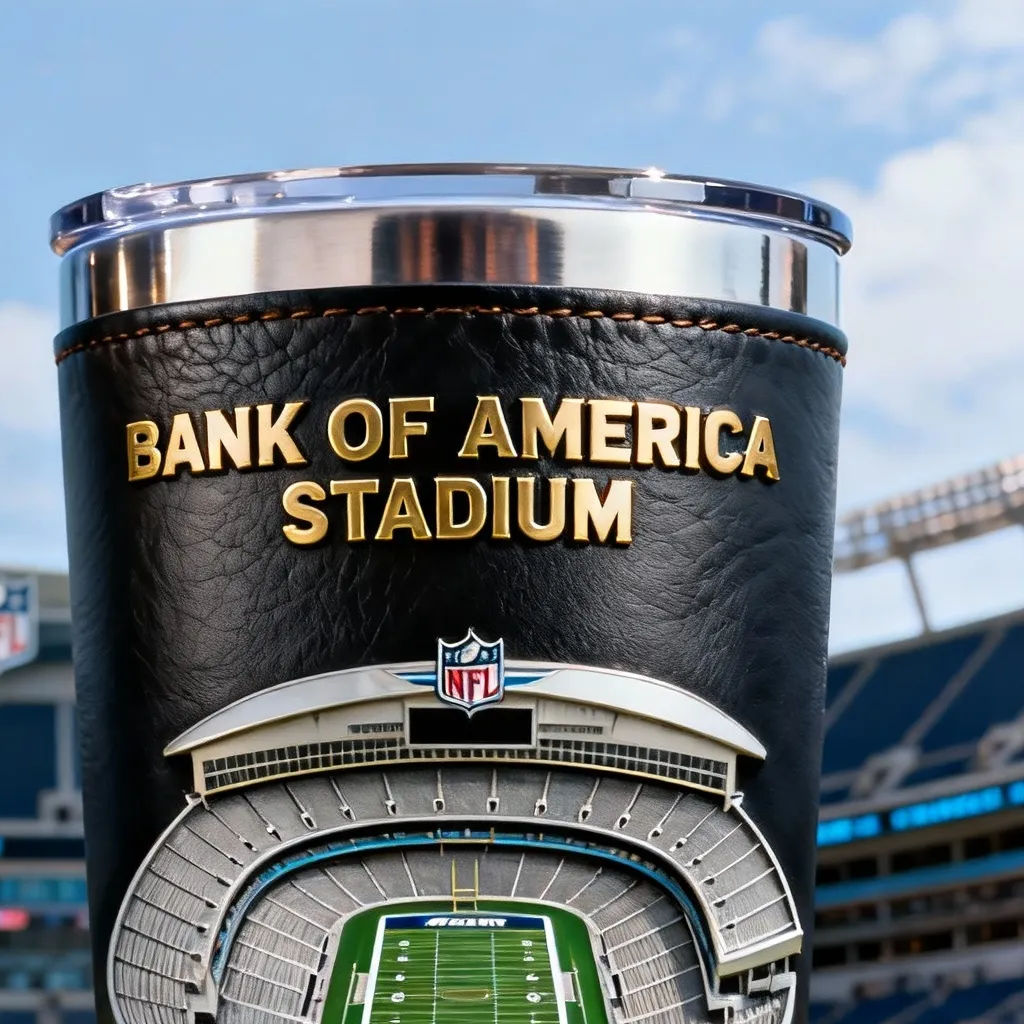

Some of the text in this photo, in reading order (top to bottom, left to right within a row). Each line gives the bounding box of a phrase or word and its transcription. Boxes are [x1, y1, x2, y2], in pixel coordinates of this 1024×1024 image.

[126, 395, 780, 483] BANK OF AMERICA
[282, 475, 633, 546] STADIUM
[444, 665, 498, 702] NFL
